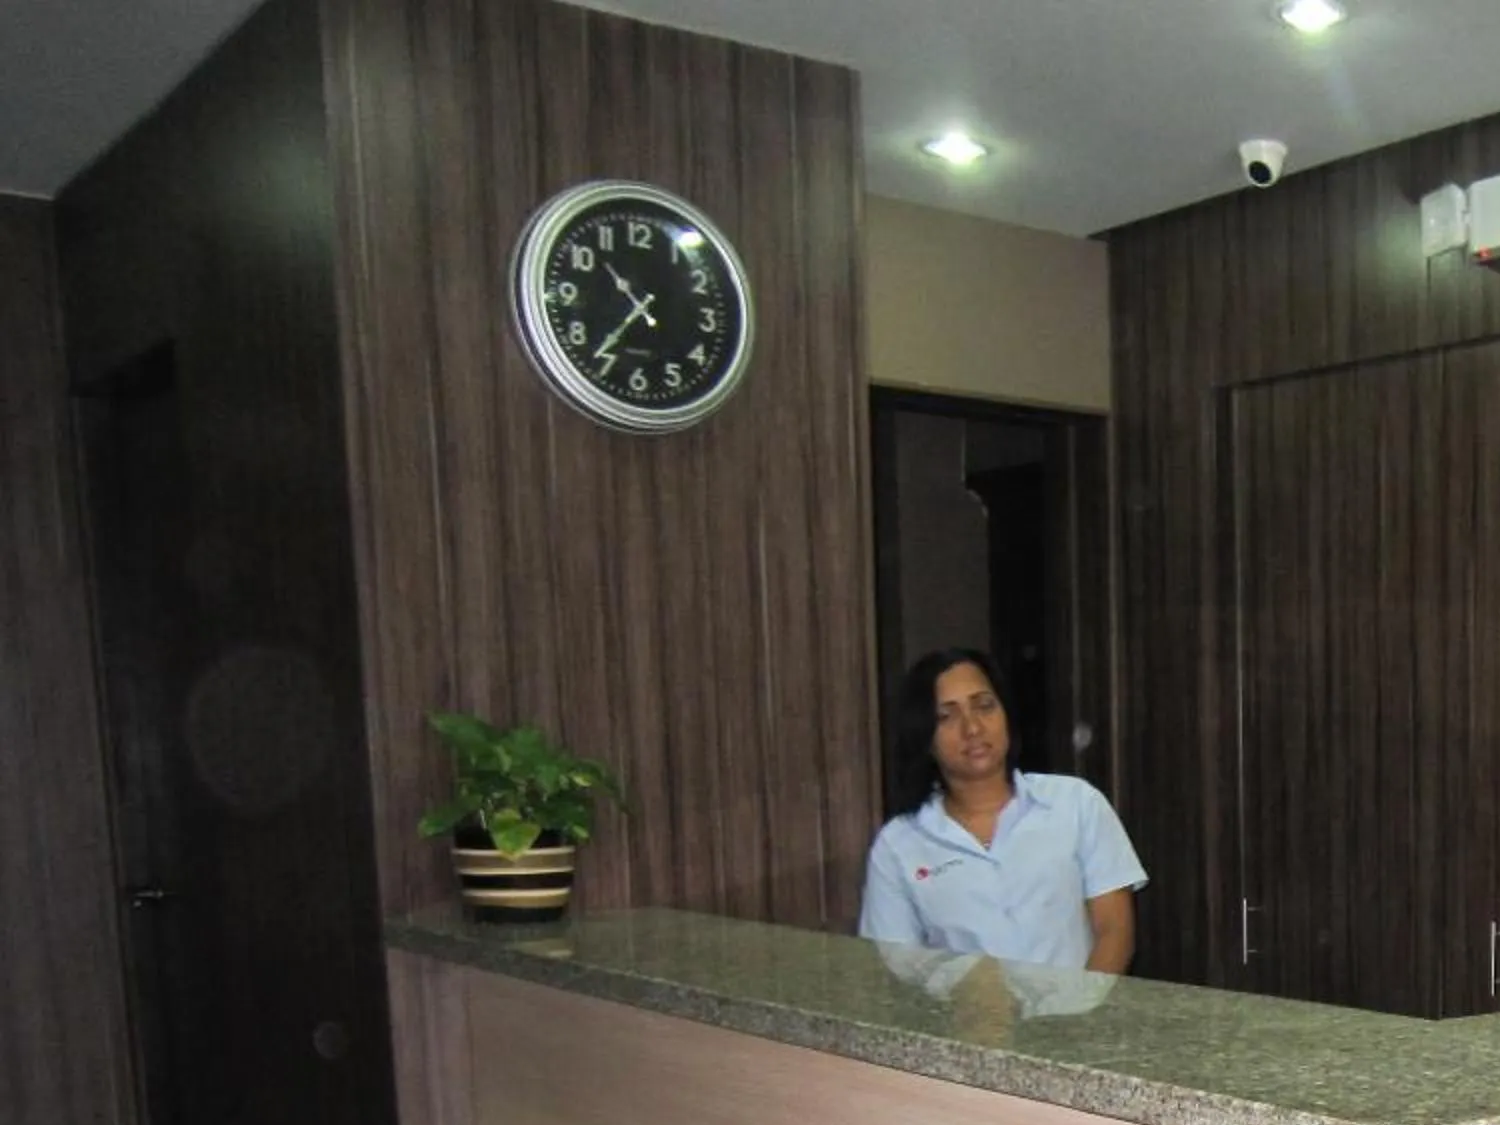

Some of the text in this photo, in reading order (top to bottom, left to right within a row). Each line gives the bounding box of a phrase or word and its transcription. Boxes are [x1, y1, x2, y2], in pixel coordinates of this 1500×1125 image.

[599, 225, 614, 251] 11
[628, 221, 653, 250] 12
[571, 244, 594, 271] 10
[558, 281, 578, 306] 9
[690, 269, 707, 295] 2
[698, 307, 716, 333] 3
[568, 321, 587, 345] 8
[597, 351, 617, 376] 7
[687, 343, 706, 366] 4
[628, 367, 648, 392] 6
[664, 362, 682, 387] 5
